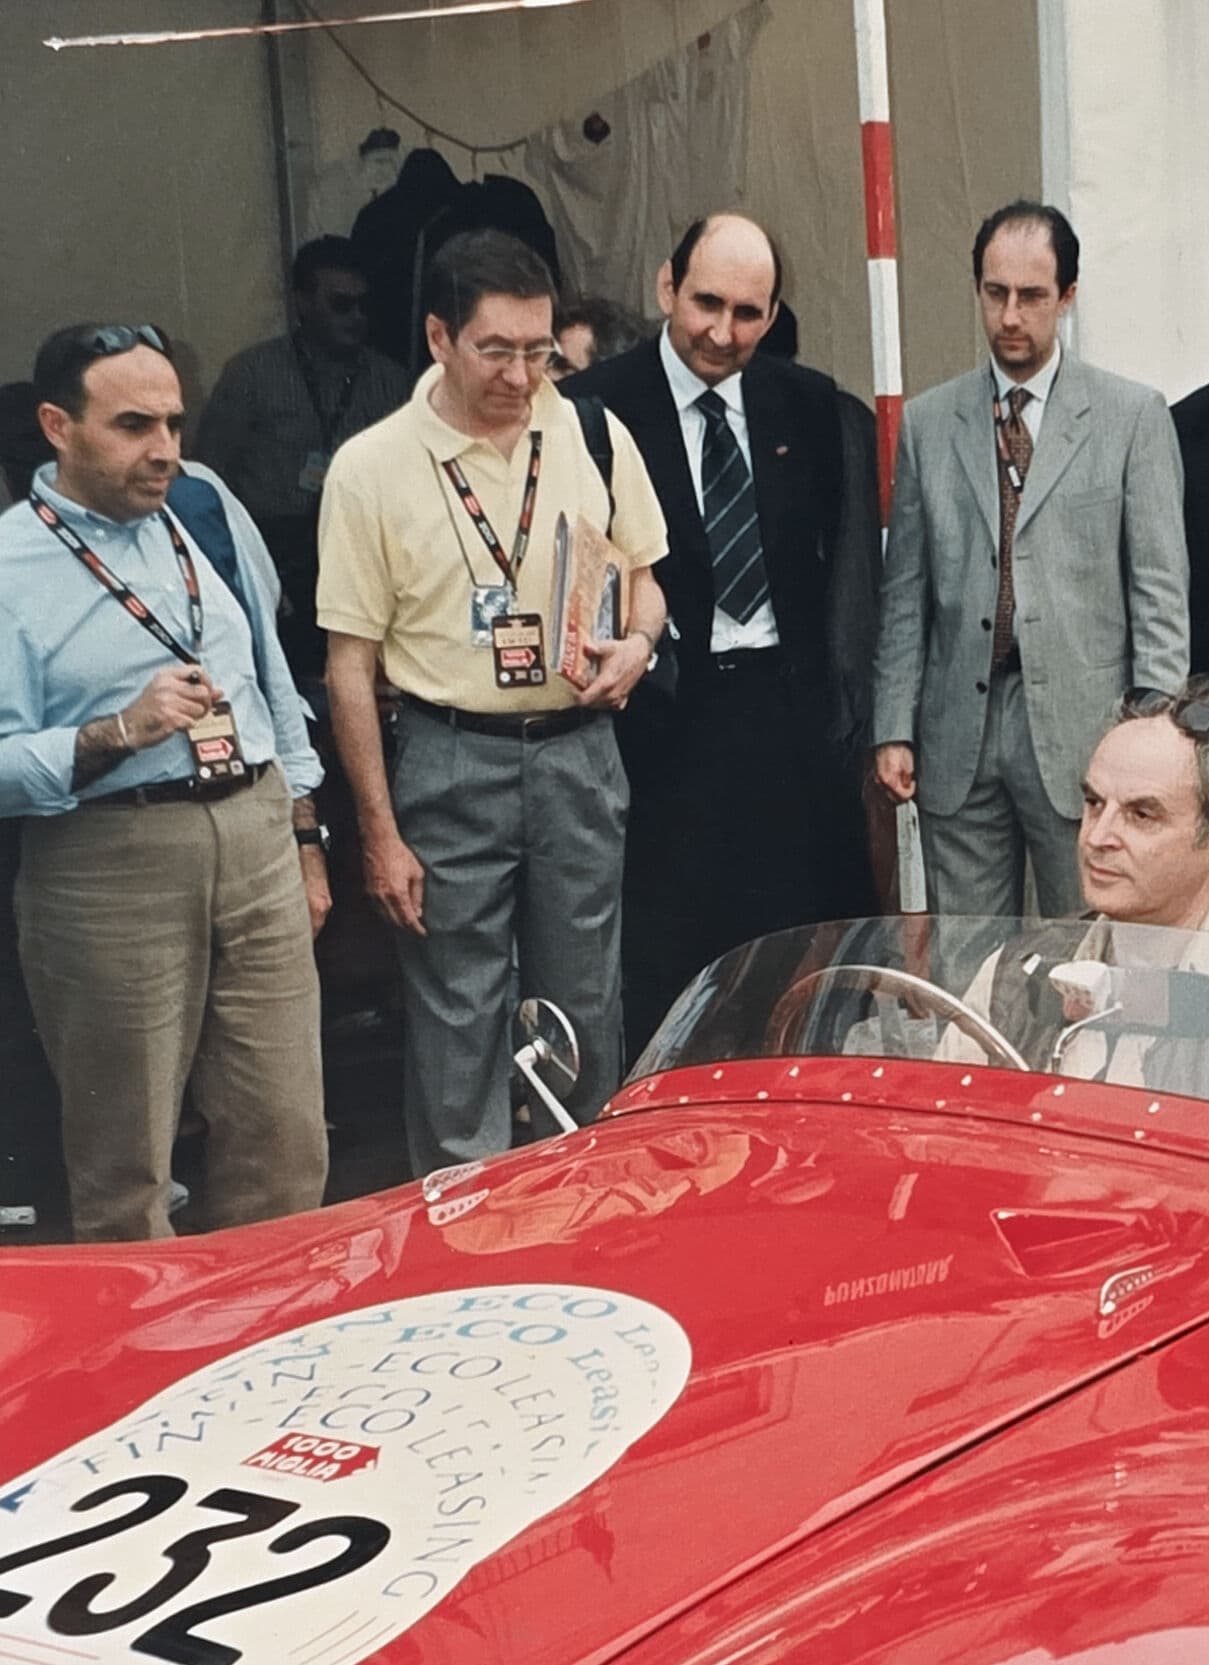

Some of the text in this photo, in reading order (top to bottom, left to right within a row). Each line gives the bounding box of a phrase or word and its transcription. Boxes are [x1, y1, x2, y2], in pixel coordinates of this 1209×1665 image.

[391, 1319, 568, 1345] ECO
[371, 1351, 502, 1379] ECO
[283, 1436, 360, 1461] 1000
[248, 1452, 342, 1479] MIGLIA
[382, 1429, 488, 1600] LEASING
[0, 1474, 392, 1665] 232
